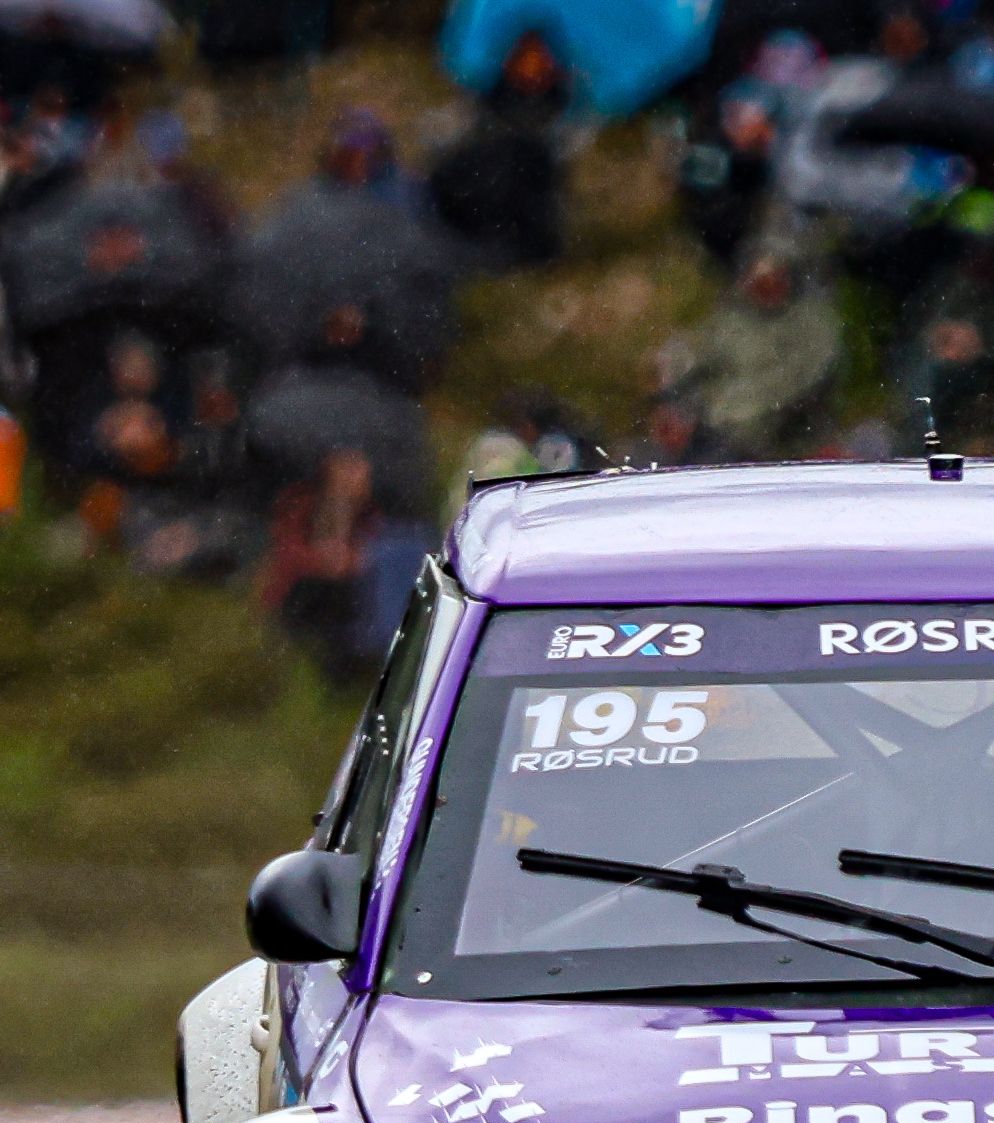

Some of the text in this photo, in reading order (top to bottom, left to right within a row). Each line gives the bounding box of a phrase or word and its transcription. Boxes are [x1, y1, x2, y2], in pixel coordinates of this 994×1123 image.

[547, 623, 704, 659] EURO RX3
[525, 691, 709, 748] 195
[511, 746, 699, 773] RØSRUD
